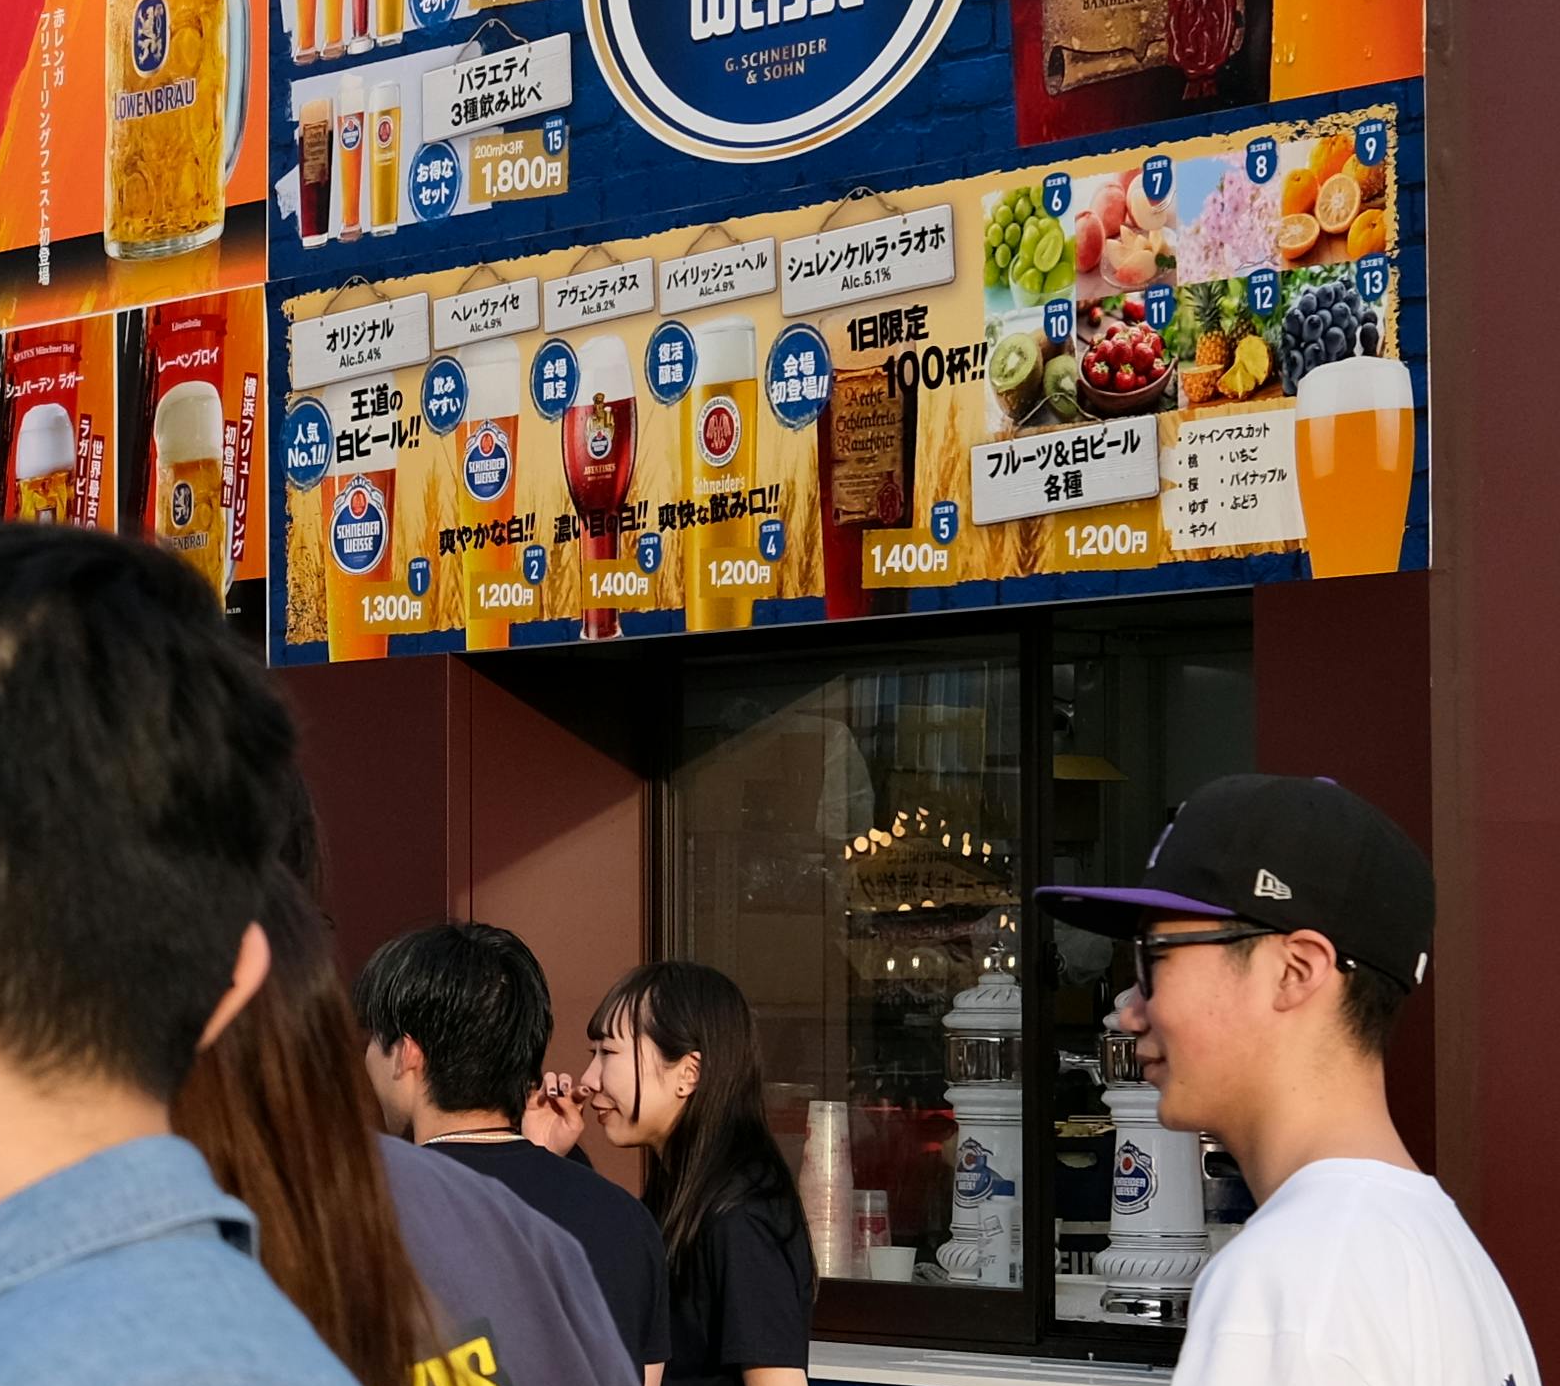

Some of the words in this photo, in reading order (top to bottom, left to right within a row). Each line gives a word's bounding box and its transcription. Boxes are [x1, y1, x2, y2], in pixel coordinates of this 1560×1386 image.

[53, 8, 66, 90] 赤レンガ
[458, 54, 531, 94] バラエティ
[746, 71, 757, 85] &
[764, 59, 806, 82] SOHN
[113, 77, 197, 121] LÖWENBRÄU
[450, 82, 543, 127] 3種飲み比べ
[38, 13, 52, 287] フリューリングフェスト初登場
[547, 130, 562, 151] 15
[1365, 136, 1377, 160] 9
[416, 159, 454, 185] お得な
[481, 156, 561, 197] 1,800円
[1255, 156, 1267, 177] 8
[1152, 173, 1163, 194] 7
[418, 187, 451, 209] セット
[1051, 191, 1062, 211] 6
[787, 223, 946, 282] シュレンケルラ・ラオホ
[665, 252, 768, 290] バイリッシュ・ヘル
[840, 267, 893, 292] Alc.5.1%
[1362, 270, 1383, 295] 13
[556, 273, 640, 308] アヴェンティヌス
[1254, 286, 1273, 309] 12
[450, 293, 520, 322] ヘレ・ヴァイセ
[1150, 303, 1167, 324] 11
[325, 317, 395, 353] オリジナル
[847, 304, 929, 352] 1日限定
[1050, 317, 1068, 339] 10
[338, 347, 382, 369] Alc.5.4%
[658, 341, 684, 362] 復活
[783, 352, 816, 376] 会場
[543, 358, 568, 379] 会場
[884, 342, 989, 399] 100杯!!
[5, 377, 55, 399] シュパーテン
[58, 371, 84, 388] ラガー
[432, 376, 456, 397] 飲み
[543, 379, 567, 401] 限定
[771, 375, 829, 404] 初登場!!
[350, 382, 403, 422] 王道の
[428, 396, 461, 418] やすい
[293, 424, 320, 445] 人気
[335, 415, 421, 464] 白ビール!!
[1187, 423, 1270, 446] シャインマスカット
[222, 424, 237, 506] 初登場!!
[287, 442, 326, 469] No.1!!
[986, 429, 1141, 479] フルーツ&白ビール
[232, 376, 258, 560] 横浜フリューリング
[1043, 472, 1083, 503] 各種
[657, 484, 781, 532] 爽快な飲み口!!
[336, 523, 381, 540] SCHNEIDER
[439, 514, 537, 556] 爽やかな白!!
[1064, 525, 1147, 557] 1,200円
[871, 543, 948, 574] 1,400円
[589, 571, 649, 597] 1,400円
[708, 560, 771, 586] 1,200円
[477, 582, 534, 608] 1,200円
[361, 596, 421, 621] 1,300円
